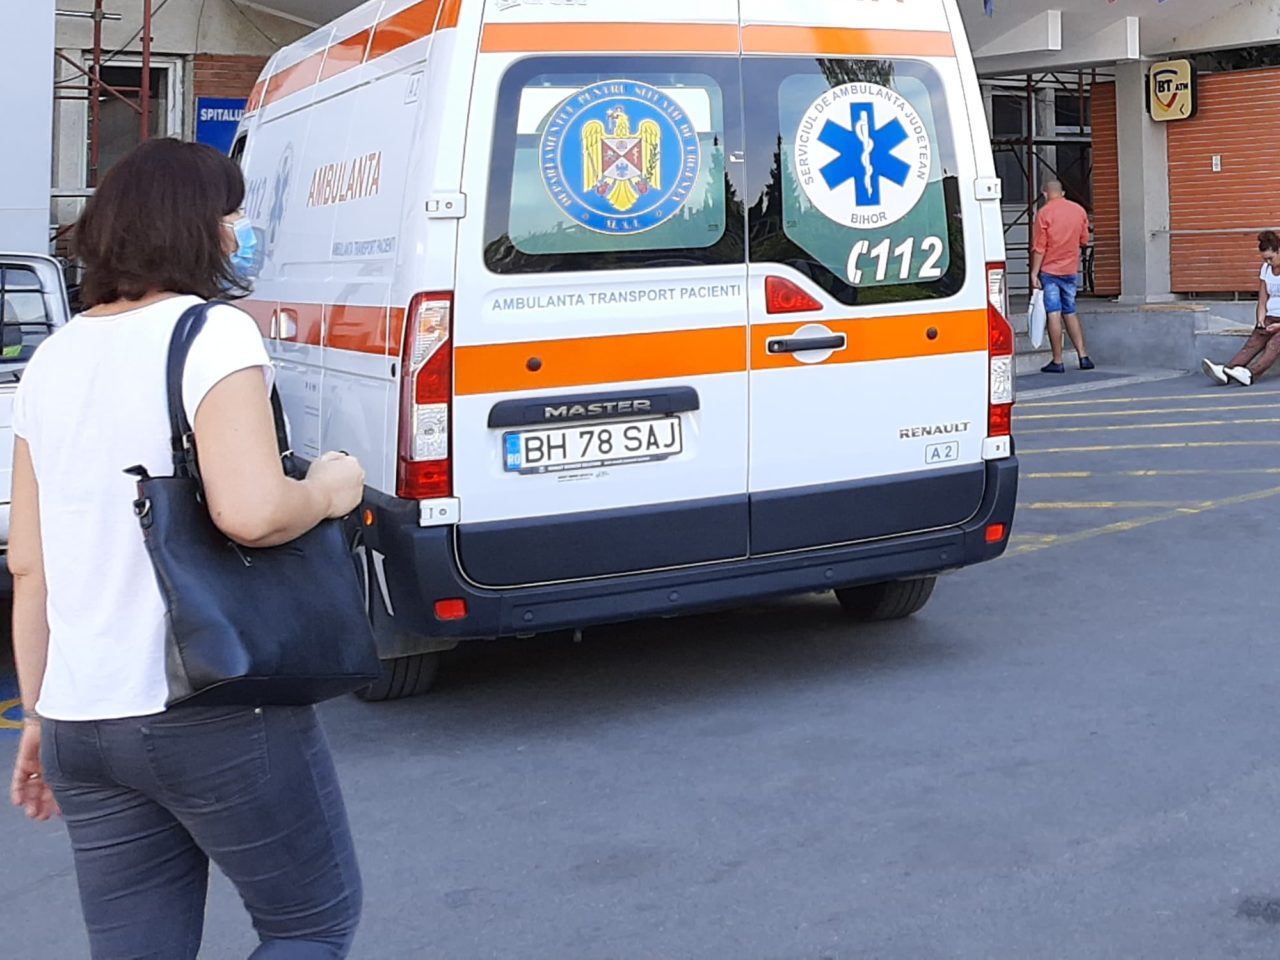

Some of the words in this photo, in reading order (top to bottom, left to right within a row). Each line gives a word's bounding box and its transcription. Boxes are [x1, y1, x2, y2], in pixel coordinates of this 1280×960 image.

[1157, 79, 1173, 93] BT
[797, 114, 818, 186] SERVICIUL
[814, 97, 833, 115] DE
[831, 83, 906, 113] AMBULANTA
[903, 110, 930, 181] JUDETEAN
[306, 151, 383, 209] AMBULANTA
[850, 210, 889, 226] BIHOR
[492, 293, 585, 312] AMBULANTA
[589, 288, 676, 306] TRANSPORT
[680, 284, 741, 299] PACIENTI
[544, 398, 651, 419] MASTER
[898, 421, 971, 440] RENAULT
[507, 453, 521, 467] RO
[523, 432, 567, 464] BH
[579, 428, 614, 458] 78
[623, 422, 676, 453] SAJ
